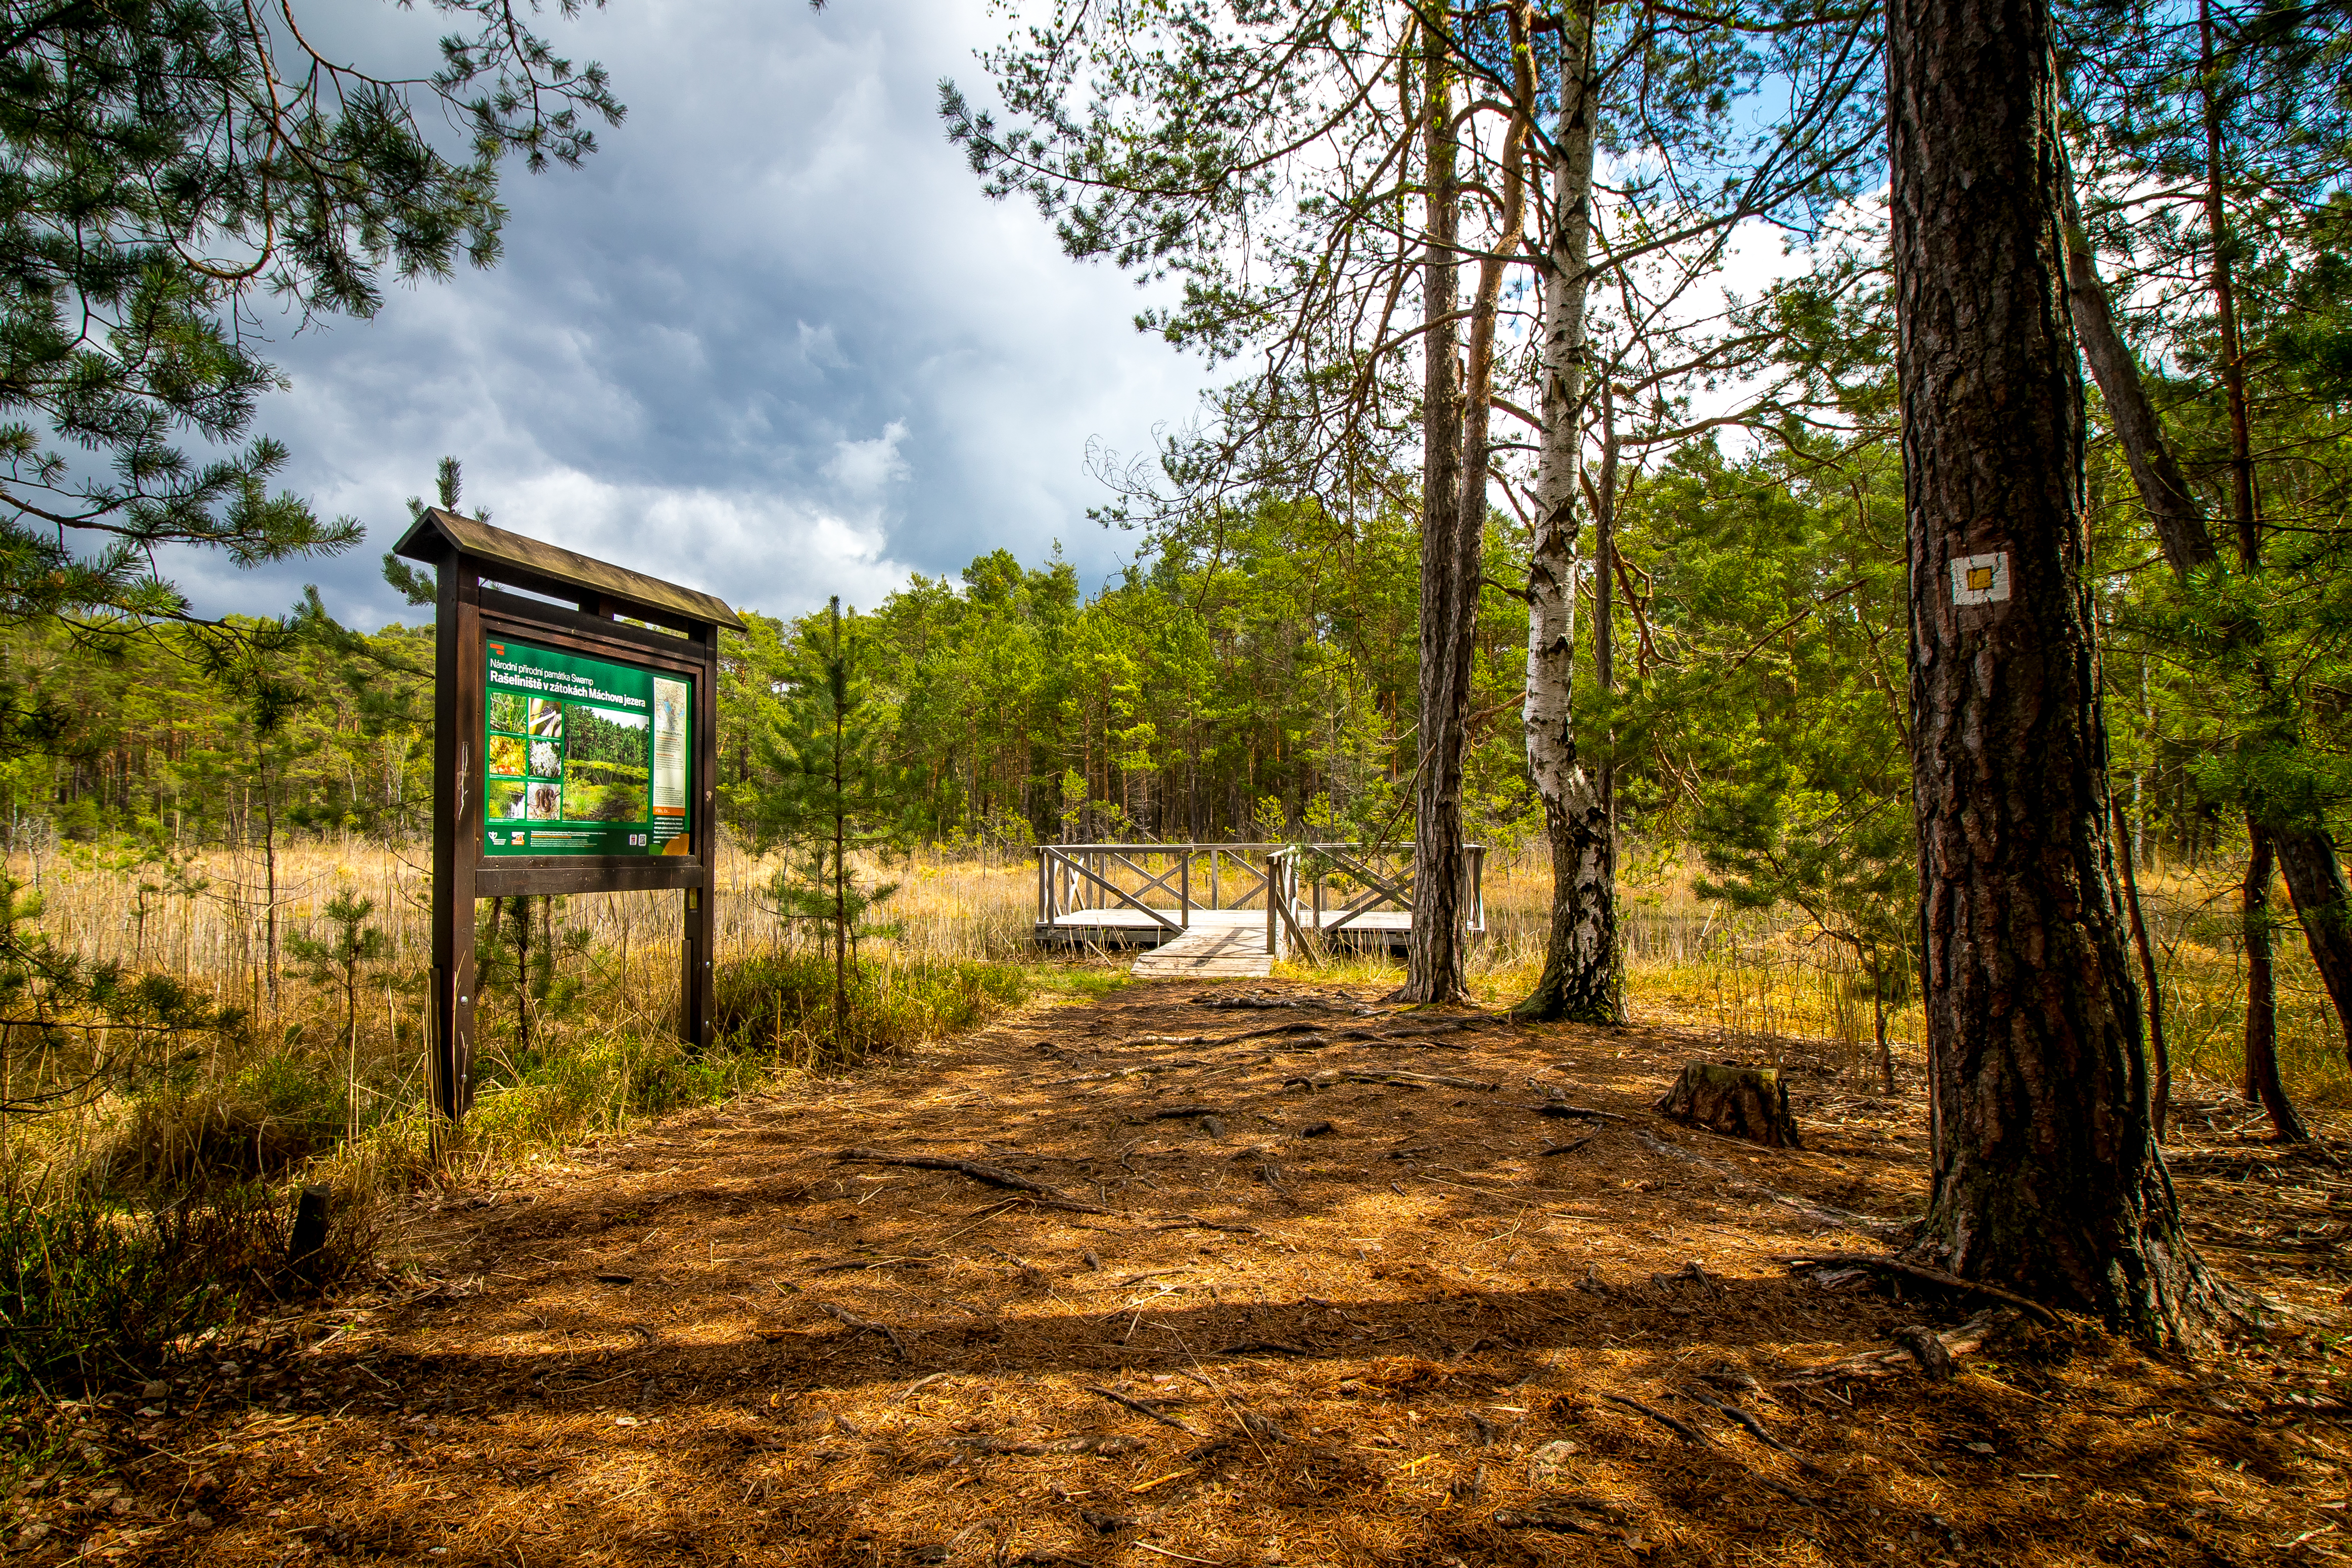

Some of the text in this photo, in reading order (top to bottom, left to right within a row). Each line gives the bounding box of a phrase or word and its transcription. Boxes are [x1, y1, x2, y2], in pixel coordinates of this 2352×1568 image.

[490, 658, 594, 687] Národní přírodní památka Swamp
[490, 670, 646, 707] Rašeliniště v zátokách Máchova jezera
